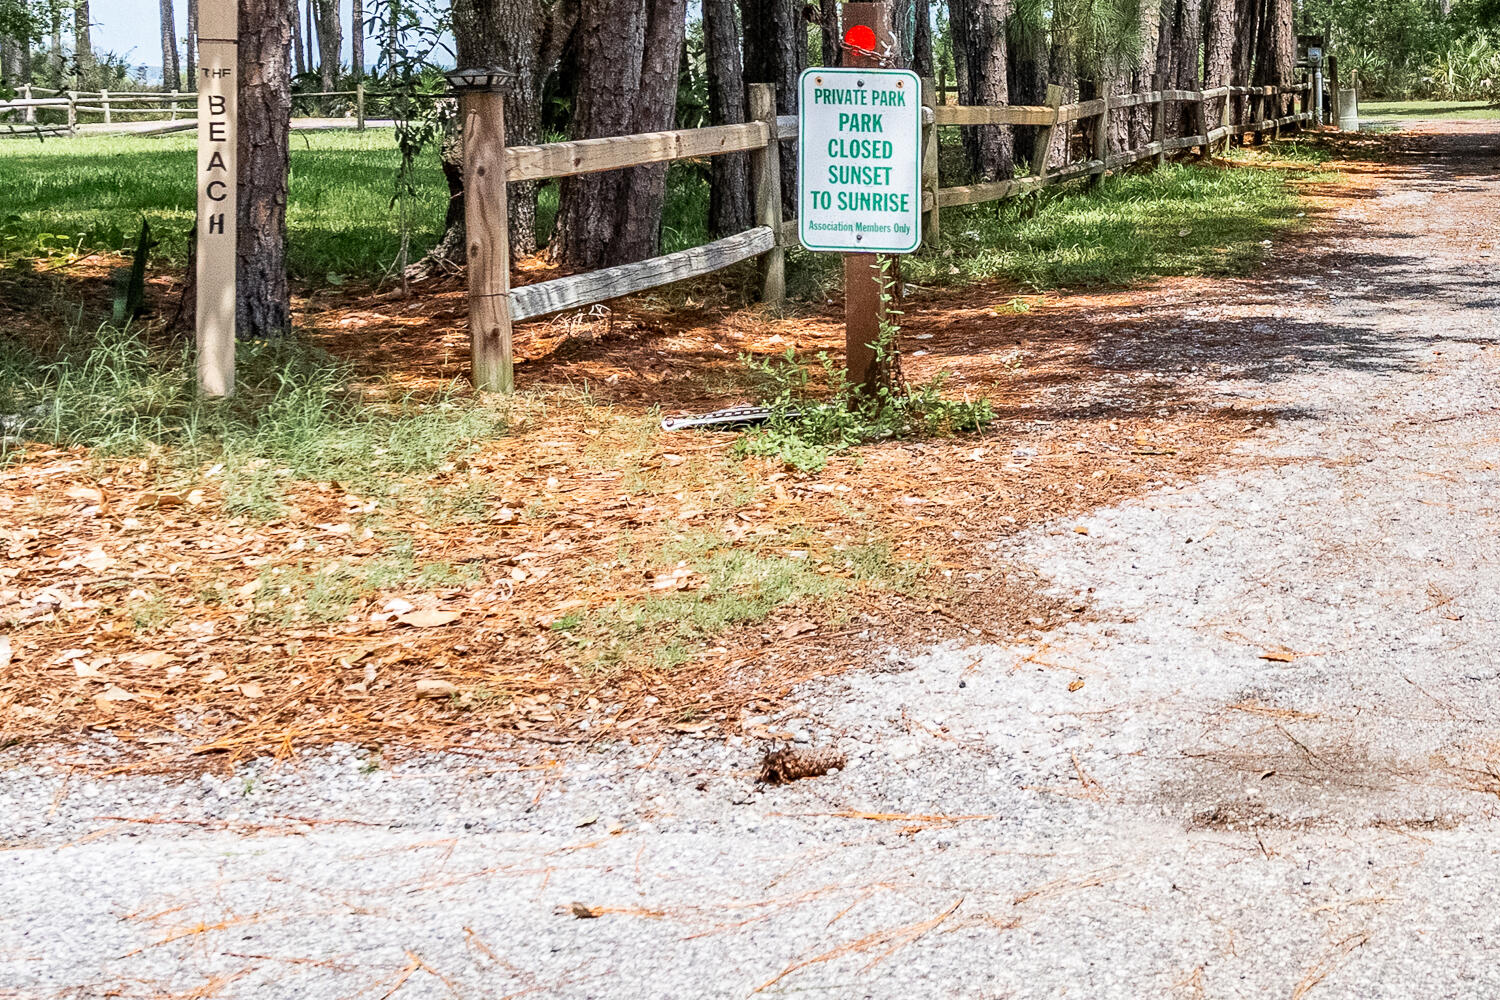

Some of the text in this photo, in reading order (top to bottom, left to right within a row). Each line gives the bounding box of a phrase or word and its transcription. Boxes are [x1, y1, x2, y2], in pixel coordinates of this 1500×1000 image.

[814, 87, 906, 107] PRIVATE PARK
[838, 112, 883, 133] PARK
[827, 138, 893, 159] CLOSED
[206, 95, 227, 235] BEACH
[828, 164, 893, 186] SUNSET
[810, 190, 910, 213] TO SUNRISE
[808, 219, 910, 235] Association Members Only
